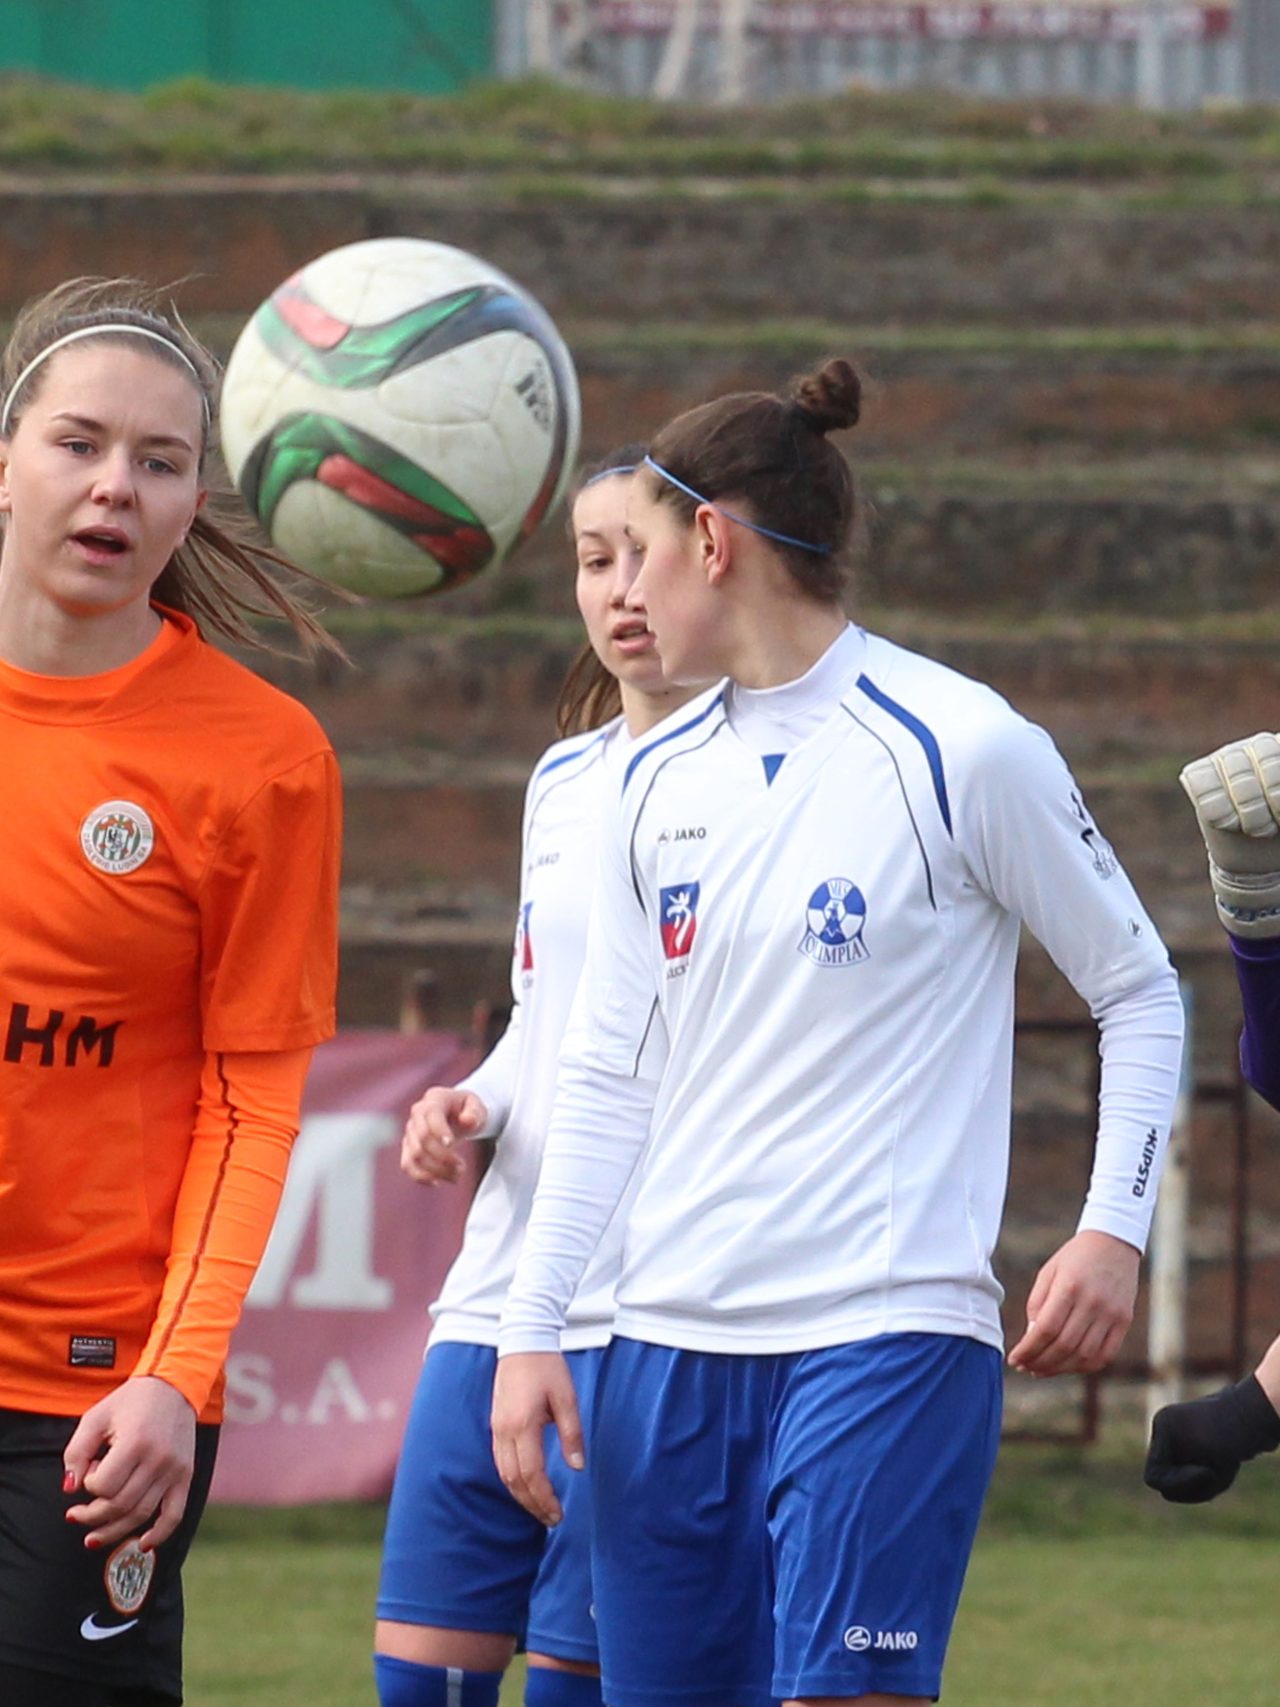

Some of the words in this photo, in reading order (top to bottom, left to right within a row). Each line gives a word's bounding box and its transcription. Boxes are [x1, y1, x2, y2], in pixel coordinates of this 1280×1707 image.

[674, 827, 707, 841] JAKO
[805, 935, 862, 963] OLIMPIA
[223, 1352, 397, 1424] S.A.
[874, 1631, 918, 1650] JAKO
